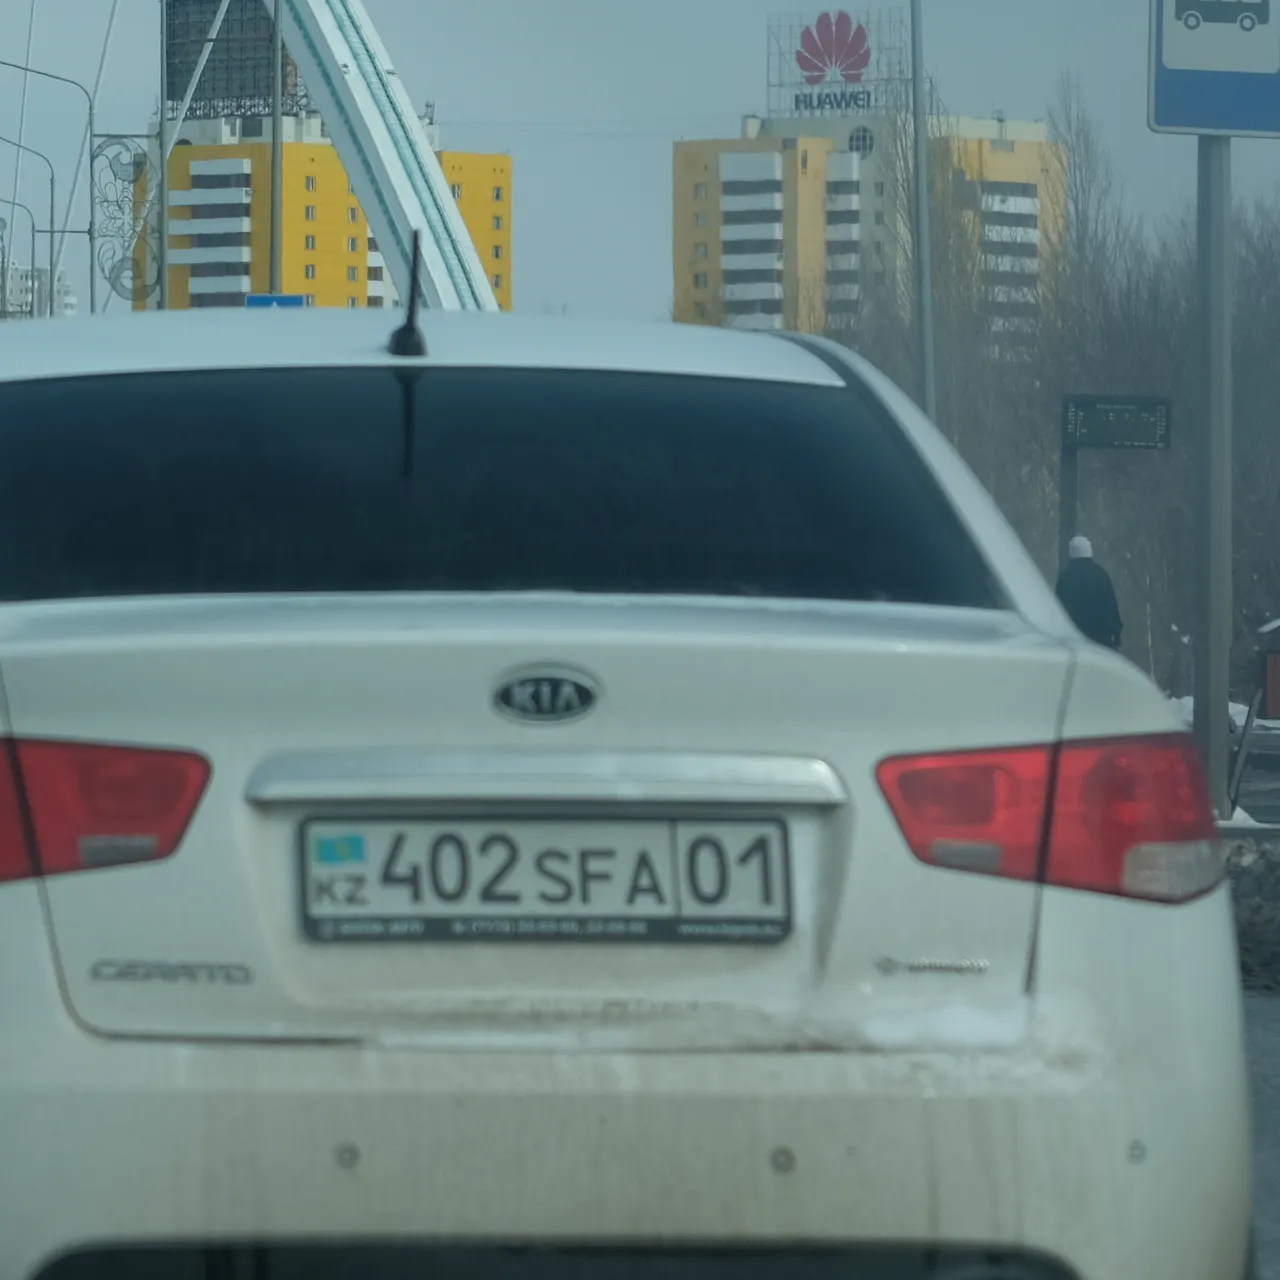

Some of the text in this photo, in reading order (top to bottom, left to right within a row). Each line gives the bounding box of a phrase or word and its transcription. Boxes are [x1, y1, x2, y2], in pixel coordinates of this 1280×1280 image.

[794, 91, 871, 111] HUAWEI
[687, 834, 776, 906] 01
[313, 873, 370, 907] KZ
